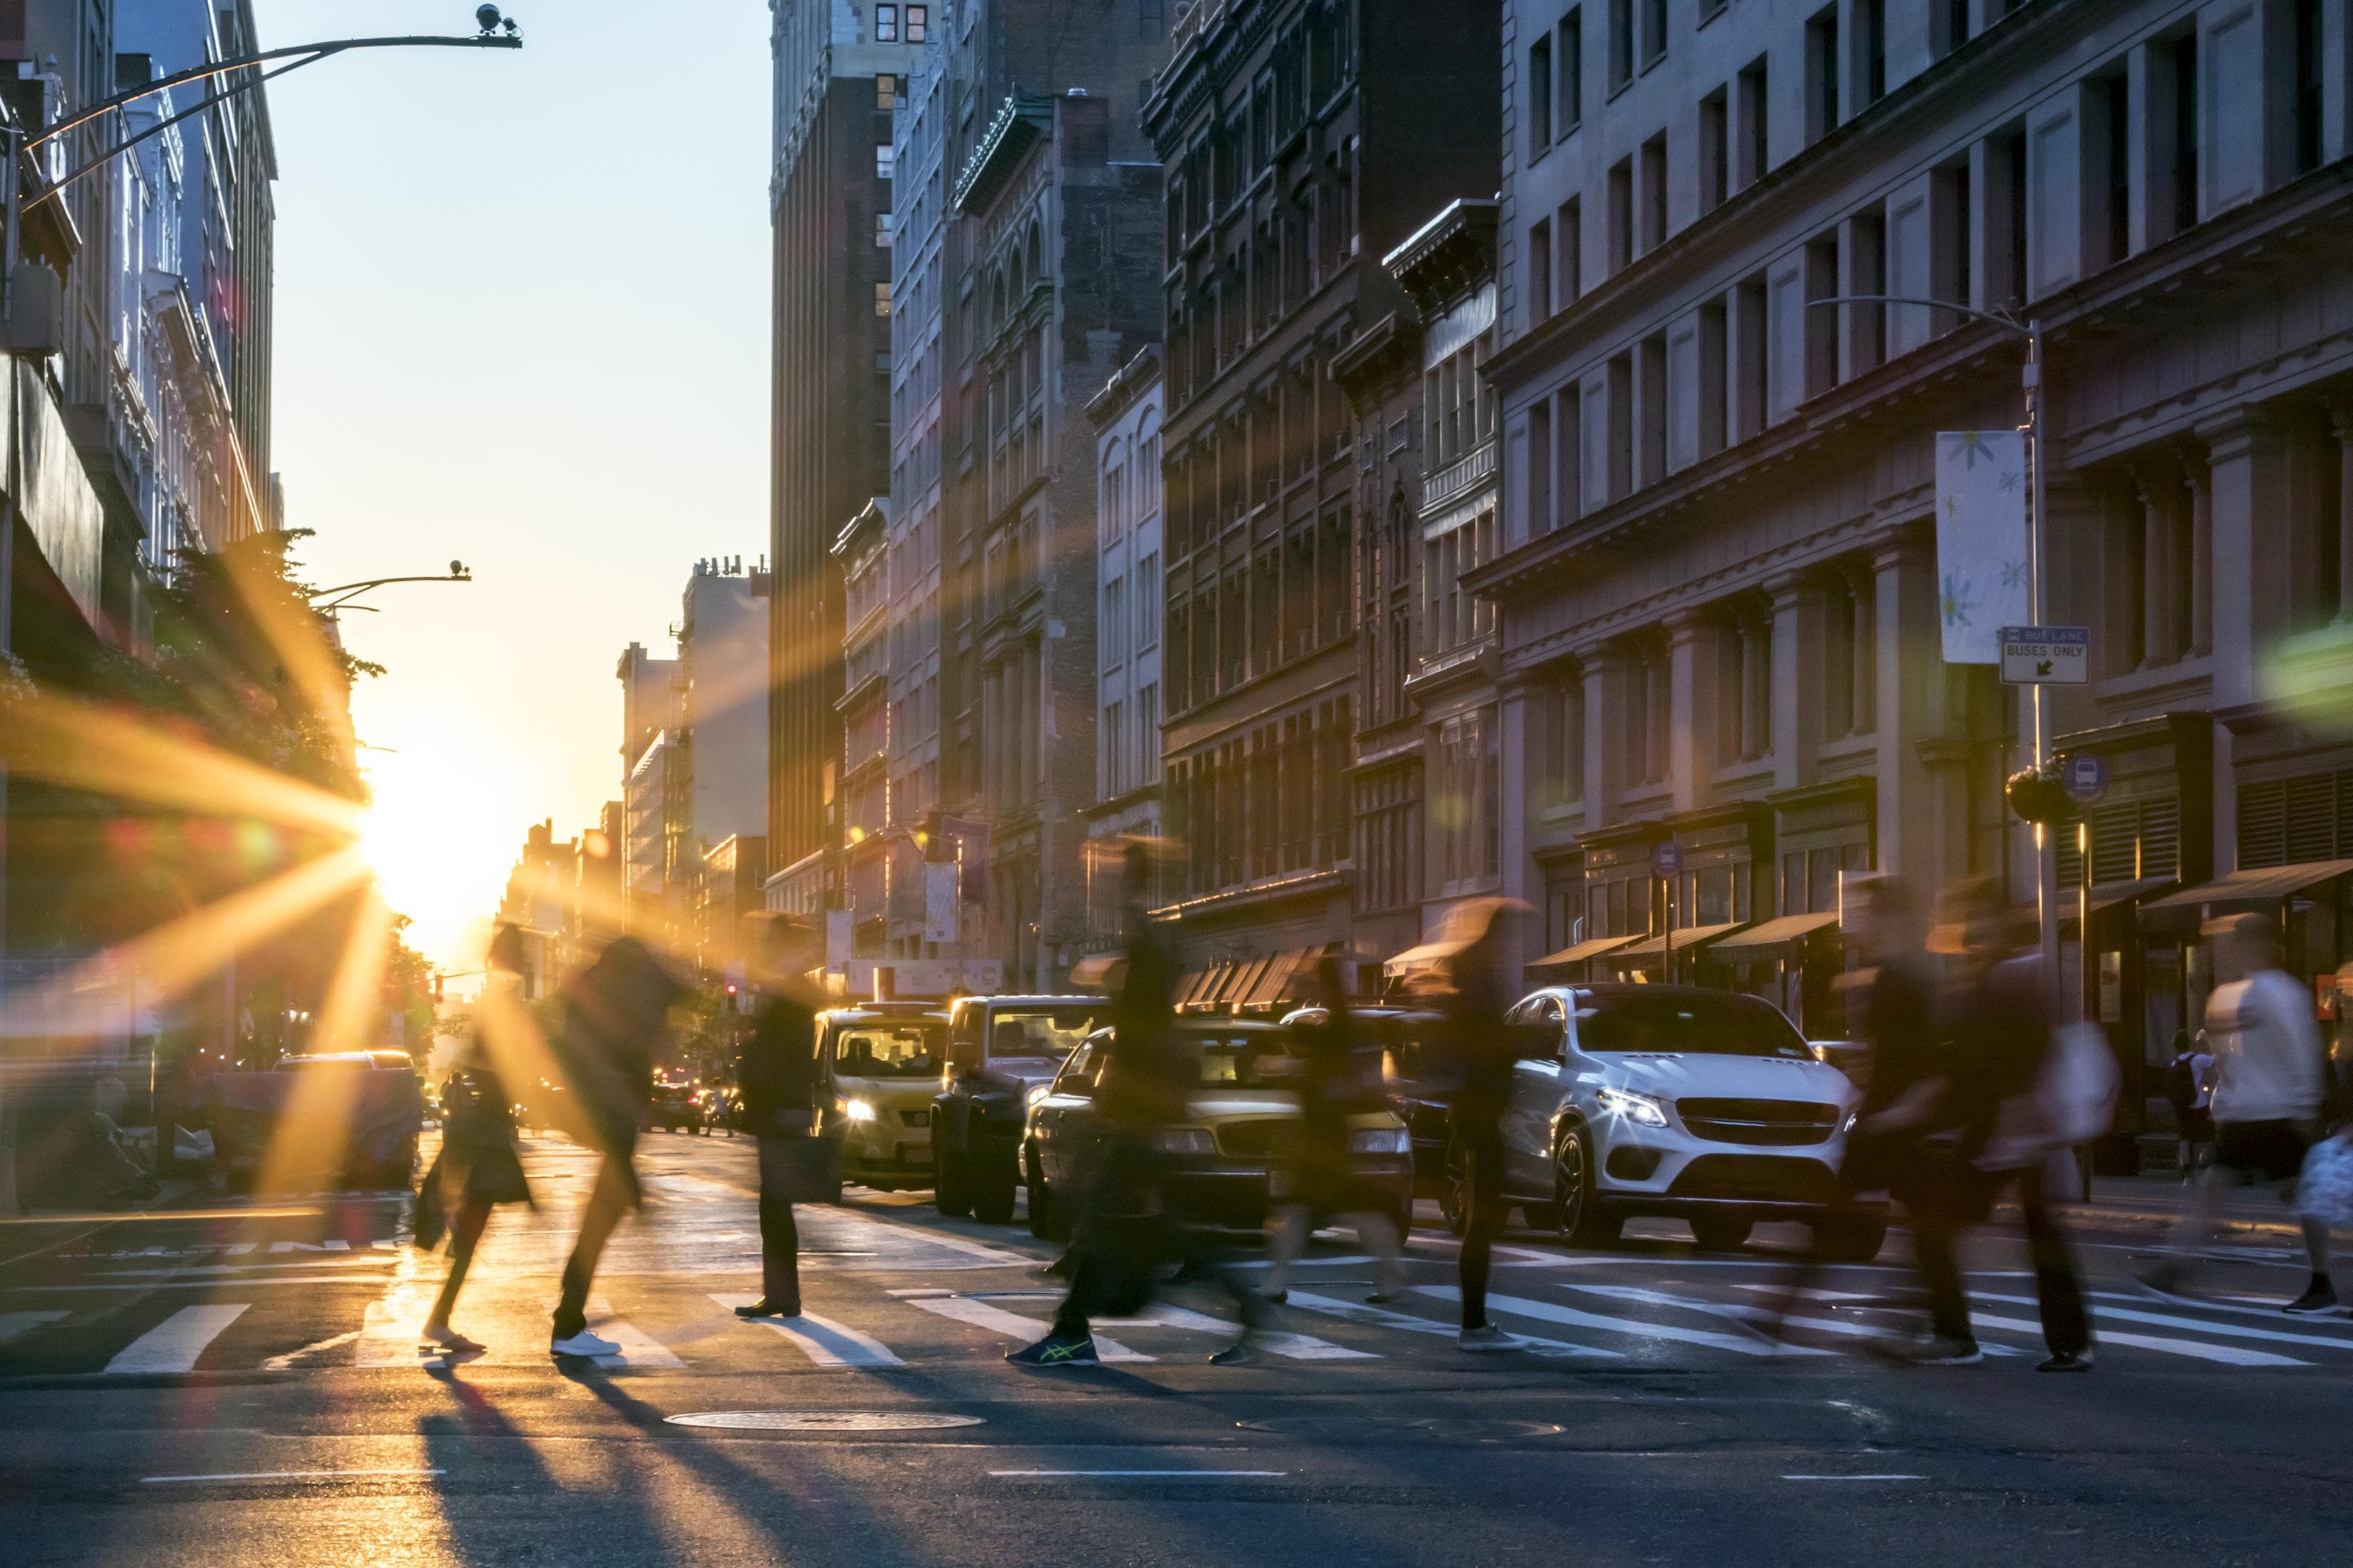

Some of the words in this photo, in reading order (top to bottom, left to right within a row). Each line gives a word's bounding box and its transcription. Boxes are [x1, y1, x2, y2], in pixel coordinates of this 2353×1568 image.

[2024, 630, 2048, 640] BUS
[2052, 631, 2084, 640] LANE
[2007, 645, 2047, 656] BUSES
[2053, 646, 2084, 657] ONLY
